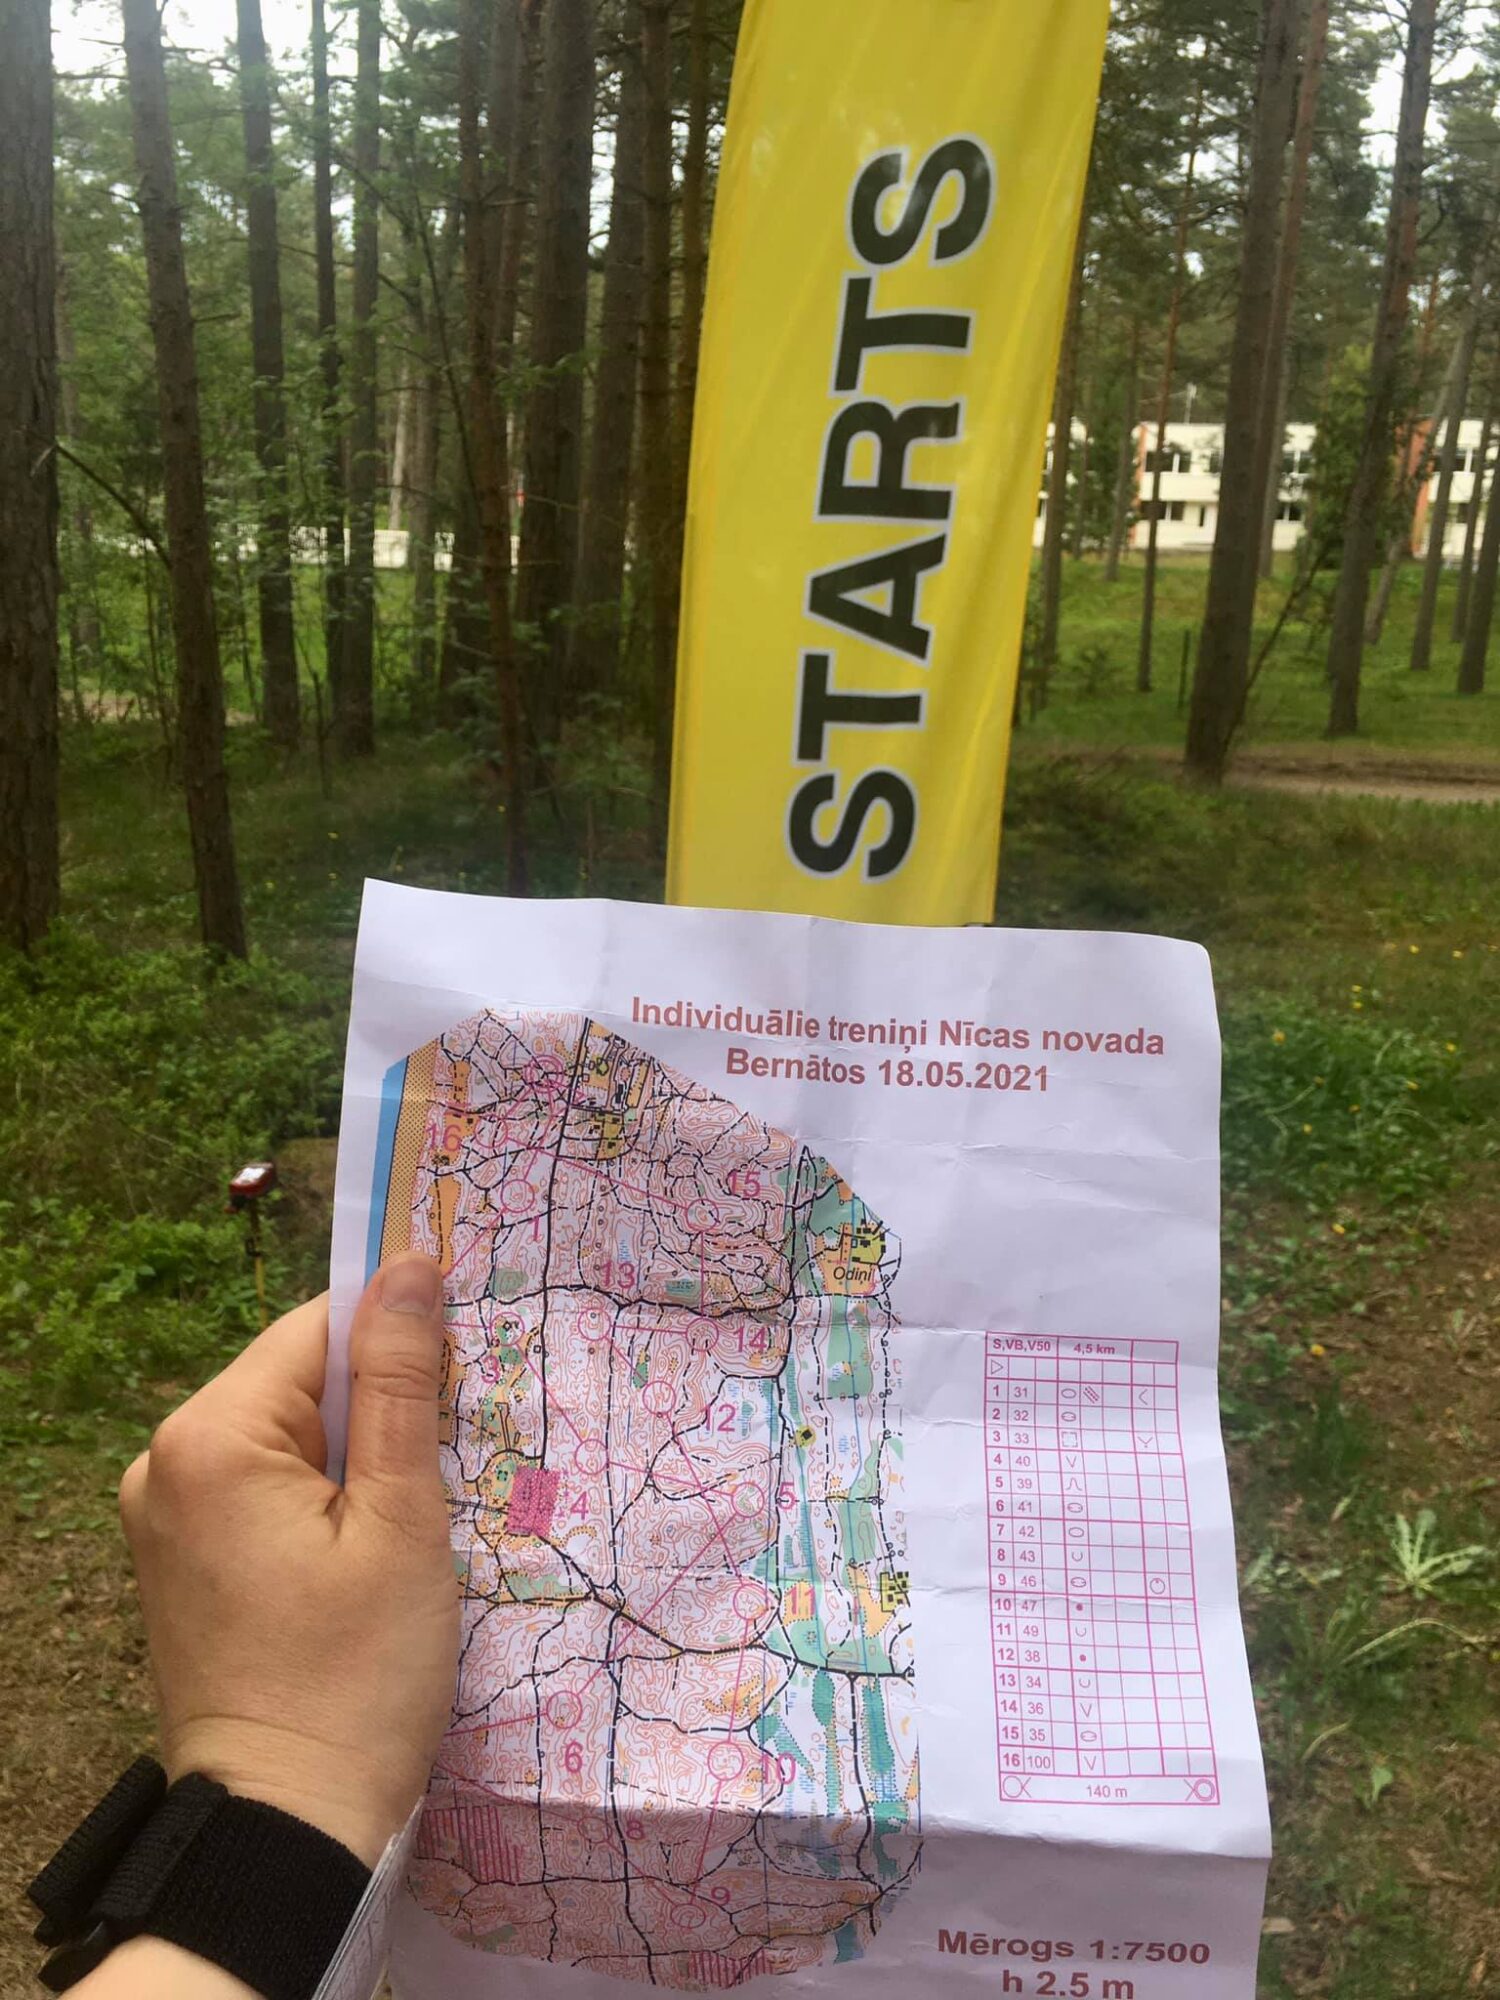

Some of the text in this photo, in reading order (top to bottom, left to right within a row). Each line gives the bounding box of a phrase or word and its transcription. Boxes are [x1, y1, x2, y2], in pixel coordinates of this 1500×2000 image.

[788, 133, 995, 883] STARTS
[631, 996, 1164, 1055] Individuālie treniņi Nīcas novada
[726, 1048, 1048, 1091] Bernātos 18.05.2021
[426, 1123, 462, 1151] 16
[728, 1171, 761, 1198] 15
[602, 1261, 636, 1286] 13
[833, 1266, 873, 1284] Odiņi
[736, 1326, 768, 1352] 14
[993, 1338, 1051, 1352] S,VB,V50
[1073, 1344, 1115, 1355] 4,5 km
[481, 1355, 500, 1383] 3
[993, 1385, 1029, 1398] 1 31
[702, 1404, 736, 1432] 12
[992, 1408, 1029, 1421] 2 32
[992, 1431, 1030, 1444] 3 33
[993, 1453, 1031, 1467] 4 40
[995, 1476, 1032, 1489] 5 39
[778, 1481, 795, 1510] 5
[570, 1491, 589, 1520] 4
[995, 1500, 1033, 1513] 6 41
[996, 1524, 1035, 1537] 7 42
[997, 1548, 1036, 1562] 8 43
[997, 1574, 1037, 1587] 9 46
[791, 1586, 816, 1615] 11
[994, 1599, 1037, 1612] 10 47
[996, 1624, 1039, 1637] 11 49
[998, 1649, 1040, 1662] 12 38
[999, 1674, 1042, 1688] 13 34
[1000, 1700, 1044, 1714] 14 36
[1002, 1726, 1045, 1741] 15 35
[564, 1740, 583, 1773] 6
[1002, 1753, 1051, 1769] 16 100
[762, 1752, 796, 1785] 10
[1086, 1785, 1128, 1798] 140 m
[626, 1820, 645, 1841] 8
[711, 1886, 731, 1906] 9
[937, 1929, 1210, 1964] Mērogs 1:7500
[1002, 1969, 1135, 2000] h 2.5 m
